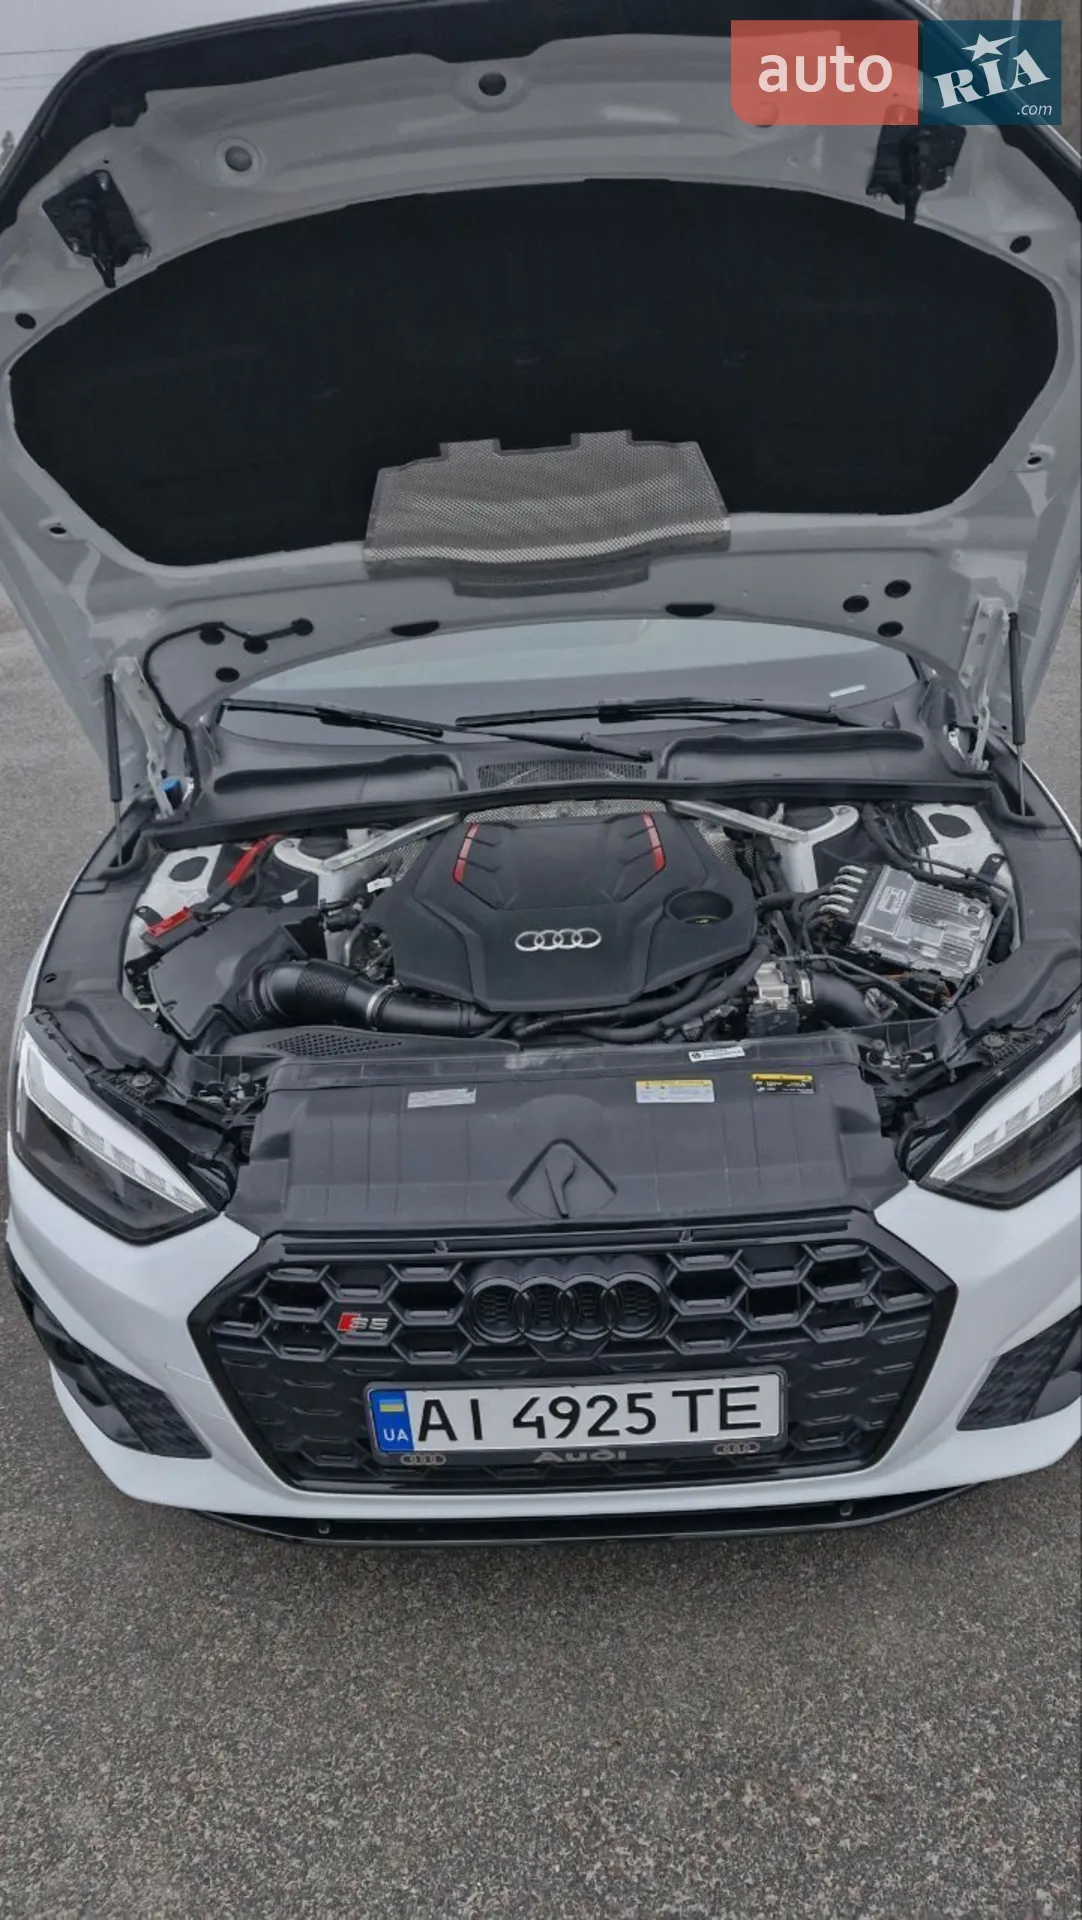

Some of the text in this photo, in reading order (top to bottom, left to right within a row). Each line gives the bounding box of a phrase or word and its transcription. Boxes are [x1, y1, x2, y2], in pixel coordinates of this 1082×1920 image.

[349, 1317, 389, 1331] S5
[418, 1385, 762, 1442] AI 4925 TE
[383, 1428, 409, 1442] UA
